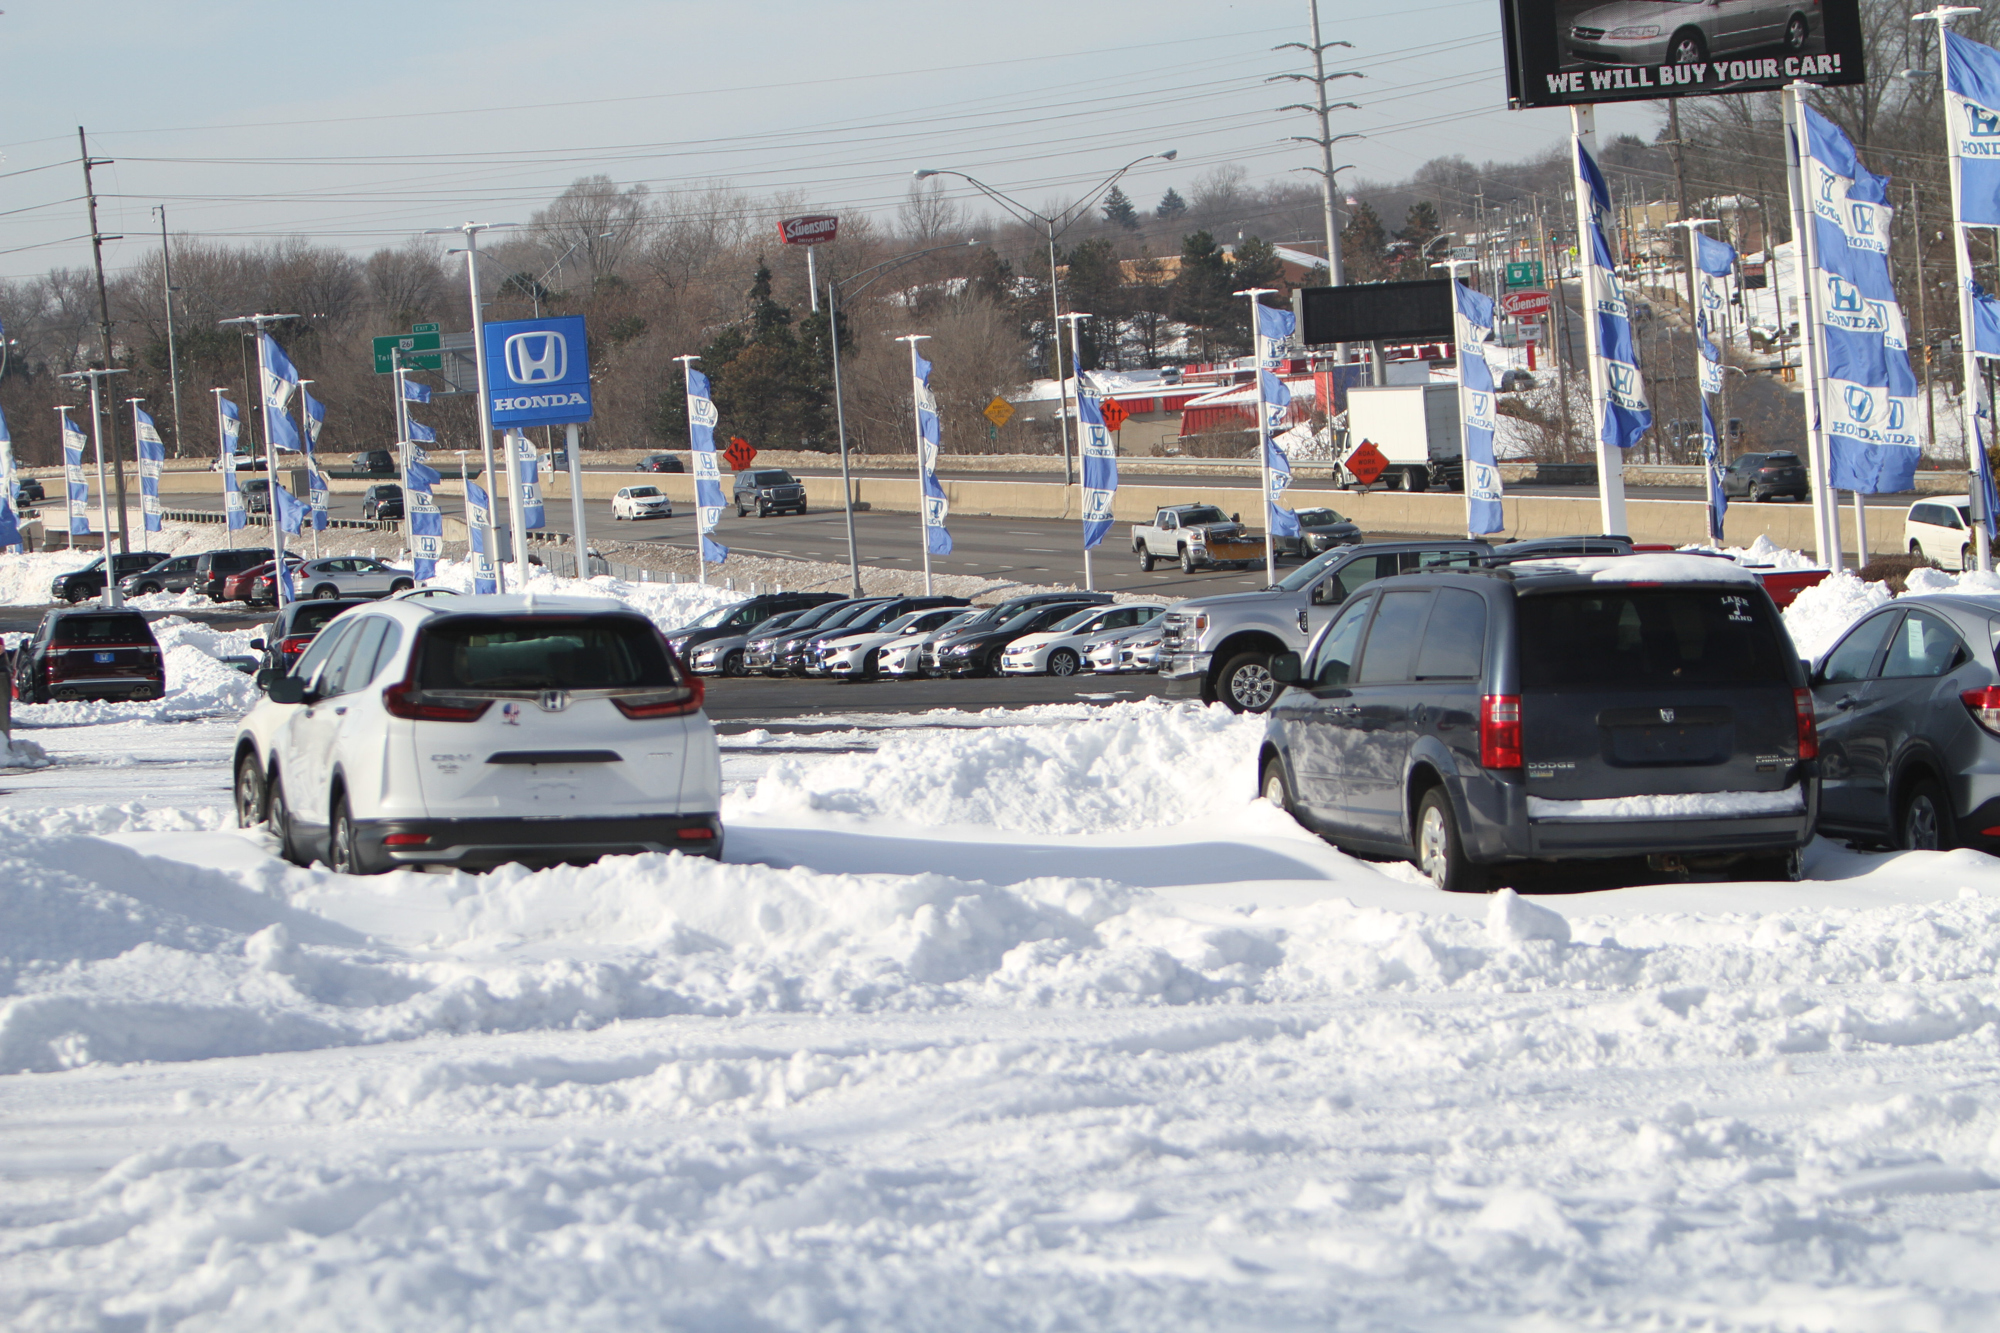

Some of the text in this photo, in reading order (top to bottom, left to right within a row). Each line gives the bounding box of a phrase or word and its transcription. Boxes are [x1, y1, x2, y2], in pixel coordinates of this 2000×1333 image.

[1546, 53, 1842, 94] WE WILL BUY YOUR CAR!
[786, 218, 836, 238] Swensons
[1505, 295, 1551, 313] Swensons
[1598, 299, 1628, 315] HON
[431, 323, 437, 331] 3
[401, 340, 413, 348] 261
[494, 393, 588, 412] HONDA
[1083, 511, 1114, 521] HODA
[1721, 595, 1749, 606] LAKE
[1728, 614, 1753, 622] BAND
[1528, 761, 1576, 769] DODGE
